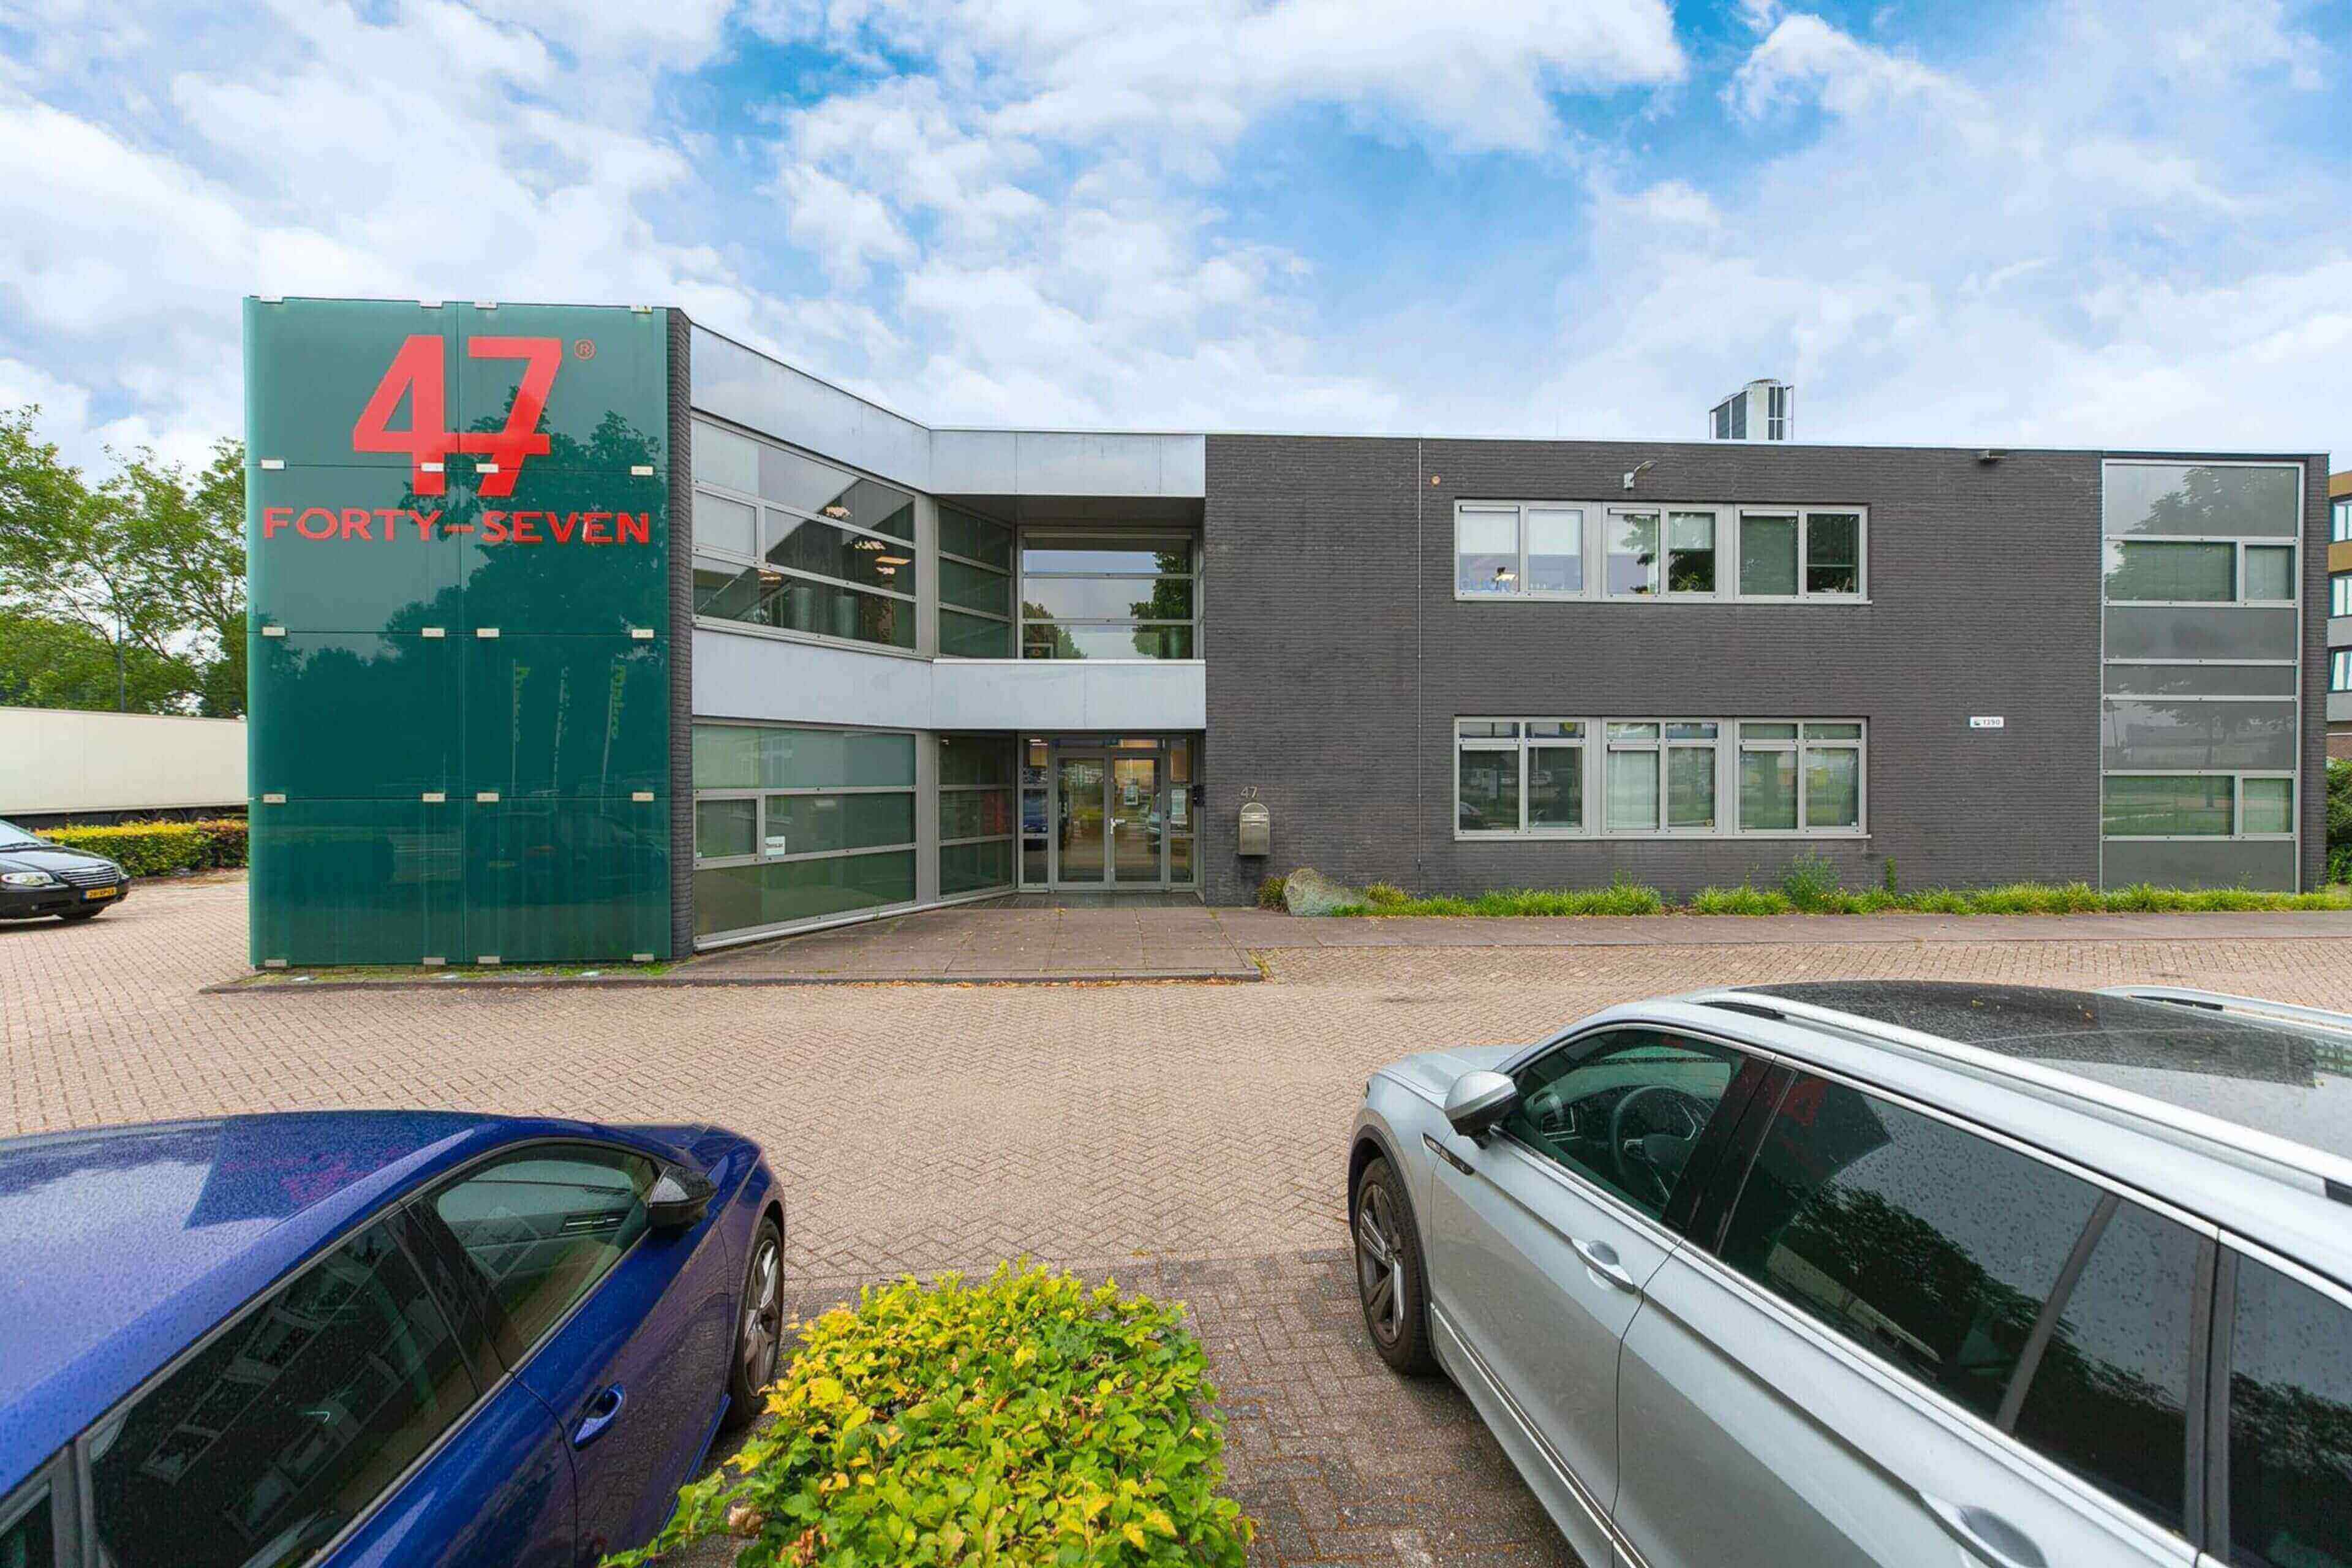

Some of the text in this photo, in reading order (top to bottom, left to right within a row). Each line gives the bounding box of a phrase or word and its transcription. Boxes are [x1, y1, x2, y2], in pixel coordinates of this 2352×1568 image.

[353, 335, 562, 496] 47
[263, 508, 649, 543] FORTY-SEVEN
[1240, 786, 1257, 798] 47
